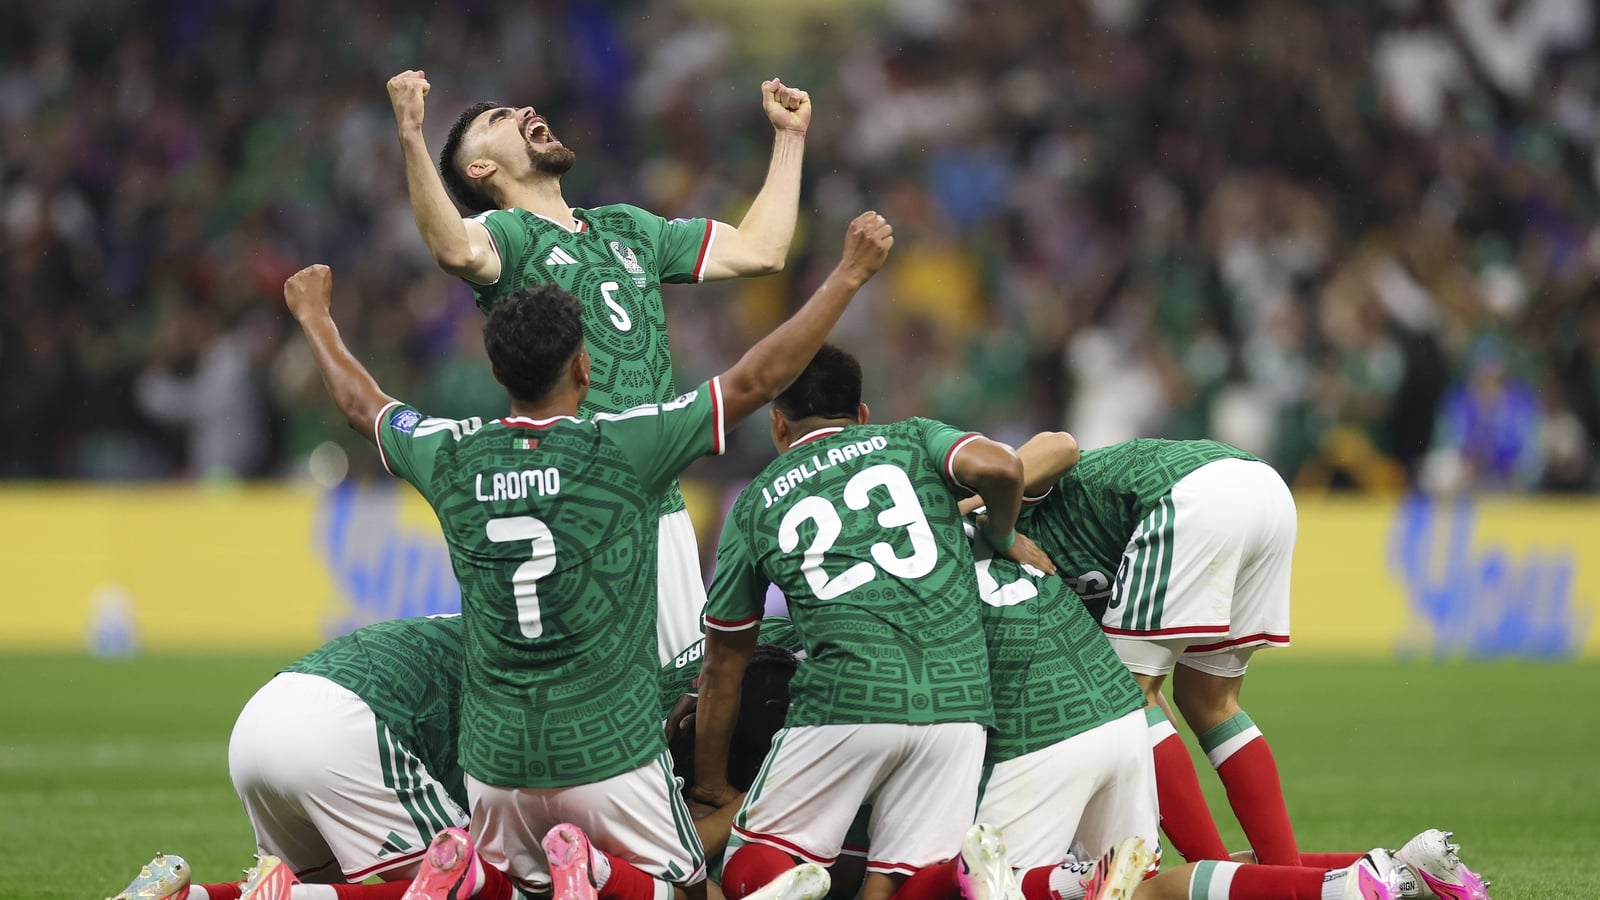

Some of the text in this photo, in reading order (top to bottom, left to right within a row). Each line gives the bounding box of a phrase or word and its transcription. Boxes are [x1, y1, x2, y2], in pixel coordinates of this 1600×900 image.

[600, 281, 632, 332] 5
[475, 467, 561, 502] L.ROMO
[761, 435, 888, 509] J.GALLARDO
[778, 463, 938, 601] 23
[485, 516, 557, 639] 7
